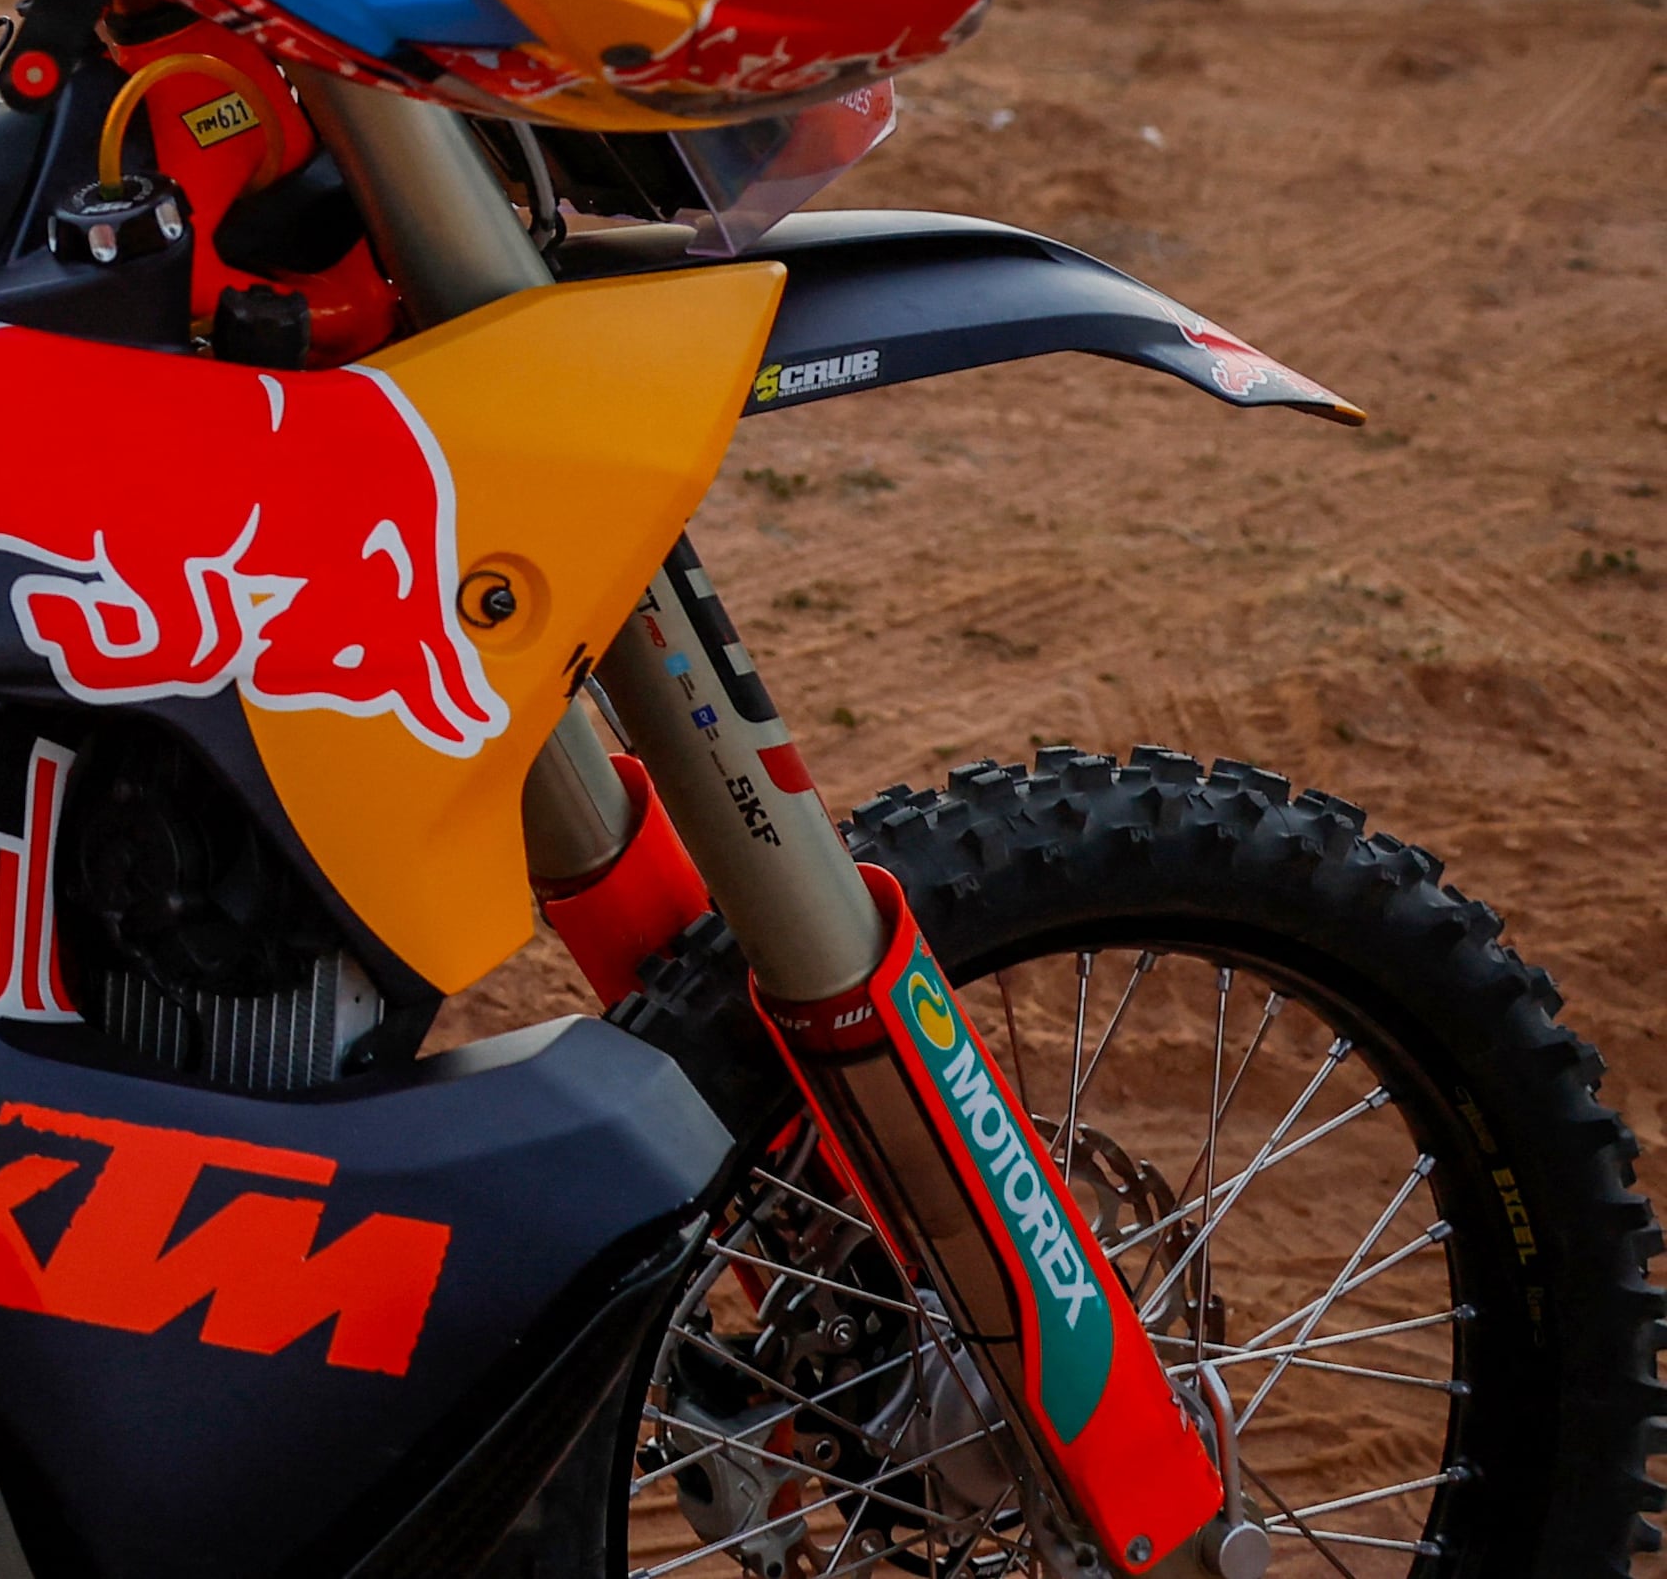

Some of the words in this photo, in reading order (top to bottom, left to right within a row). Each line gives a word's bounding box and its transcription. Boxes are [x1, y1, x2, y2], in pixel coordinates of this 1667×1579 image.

[217, 100, 249, 129] 621
[754, 349, 881, 403] SCRUB
[726, 774, 781, 847] SKF
[941, 1039, 1100, 1331] MOTOREX
[1492, 1167, 1537, 1266] EXCEL
